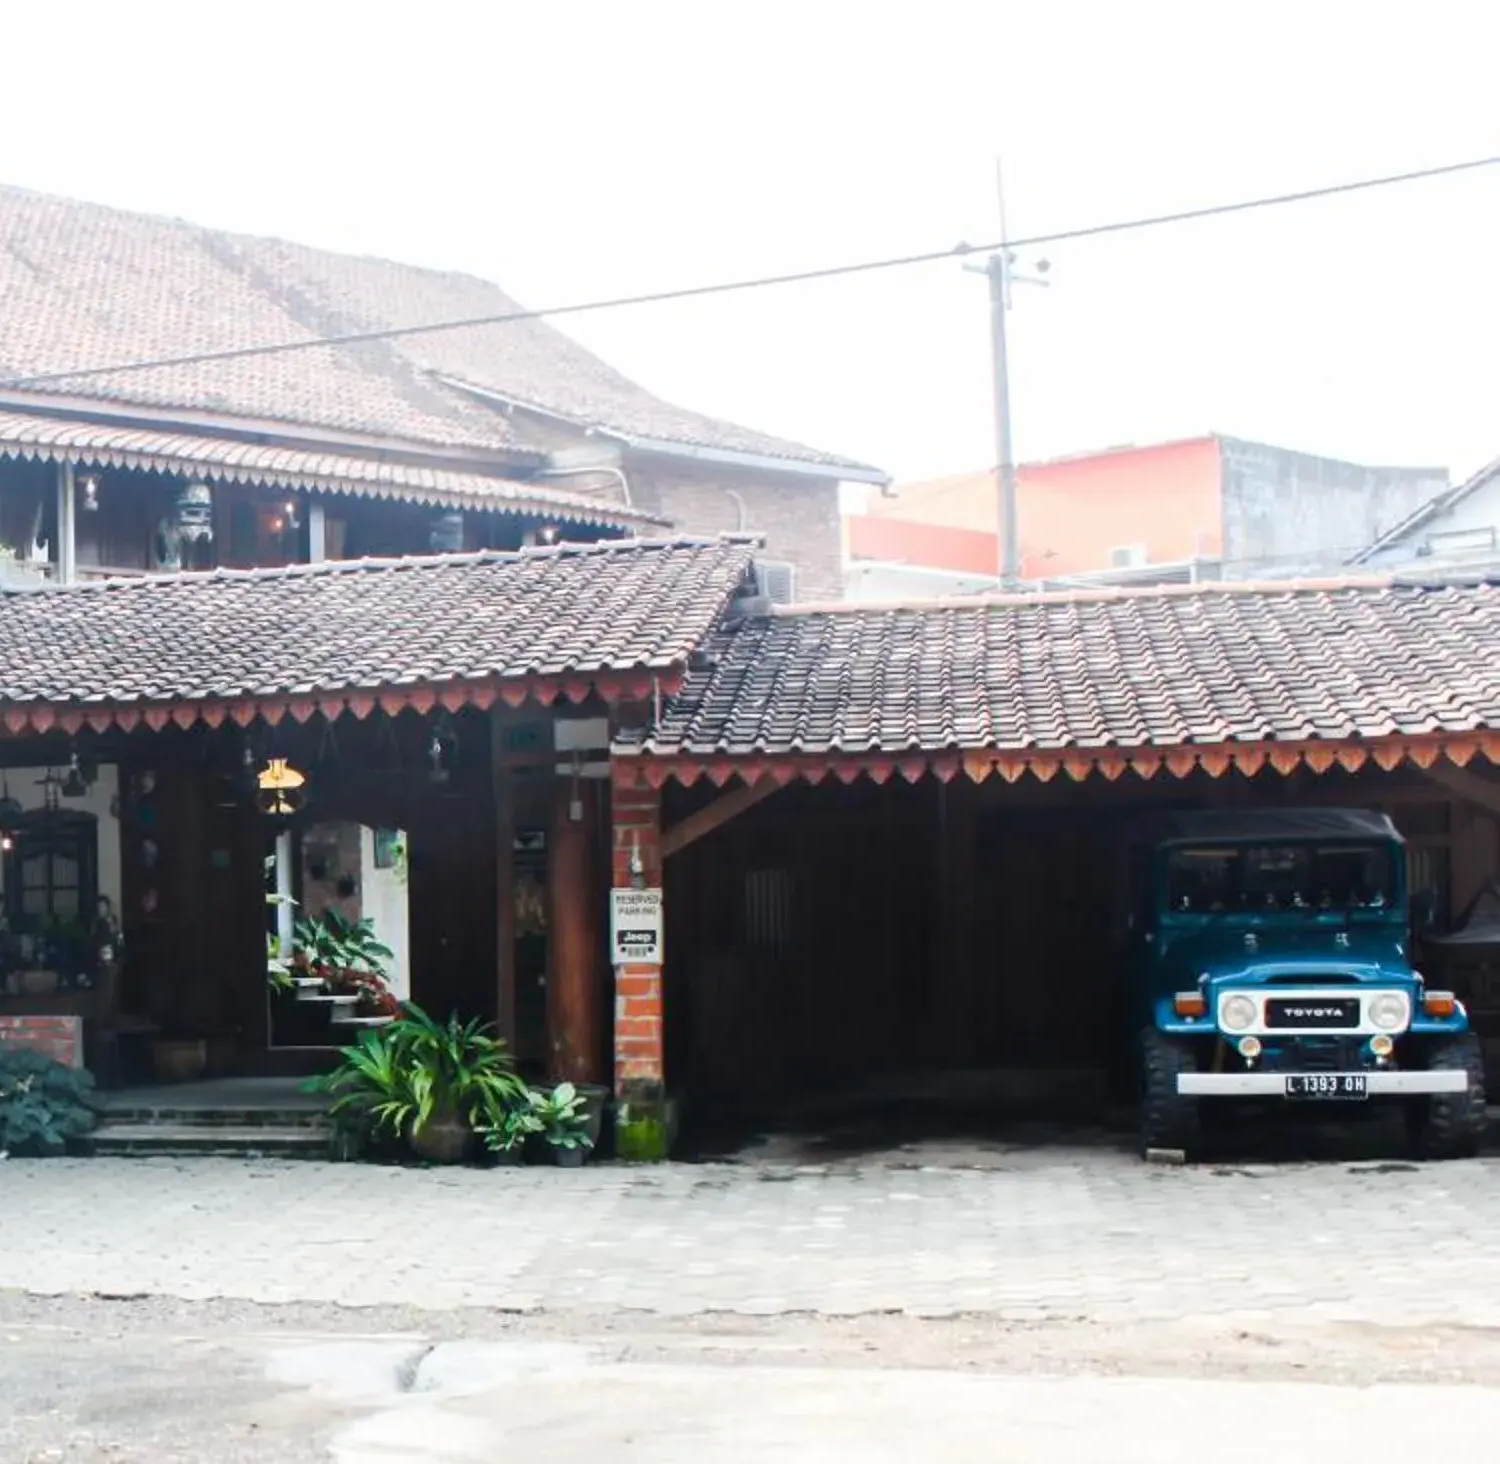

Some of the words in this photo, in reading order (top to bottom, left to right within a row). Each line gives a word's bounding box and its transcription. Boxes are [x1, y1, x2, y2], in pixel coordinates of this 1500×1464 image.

[618, 906, 657, 915] PARKING
[623, 931, 652, 943] Jeep
[1283, 1007, 1344, 1017] TOYOTA
[1287, 1077, 1296, 1092] L
[1303, 1076, 1337, 1092] 1393
